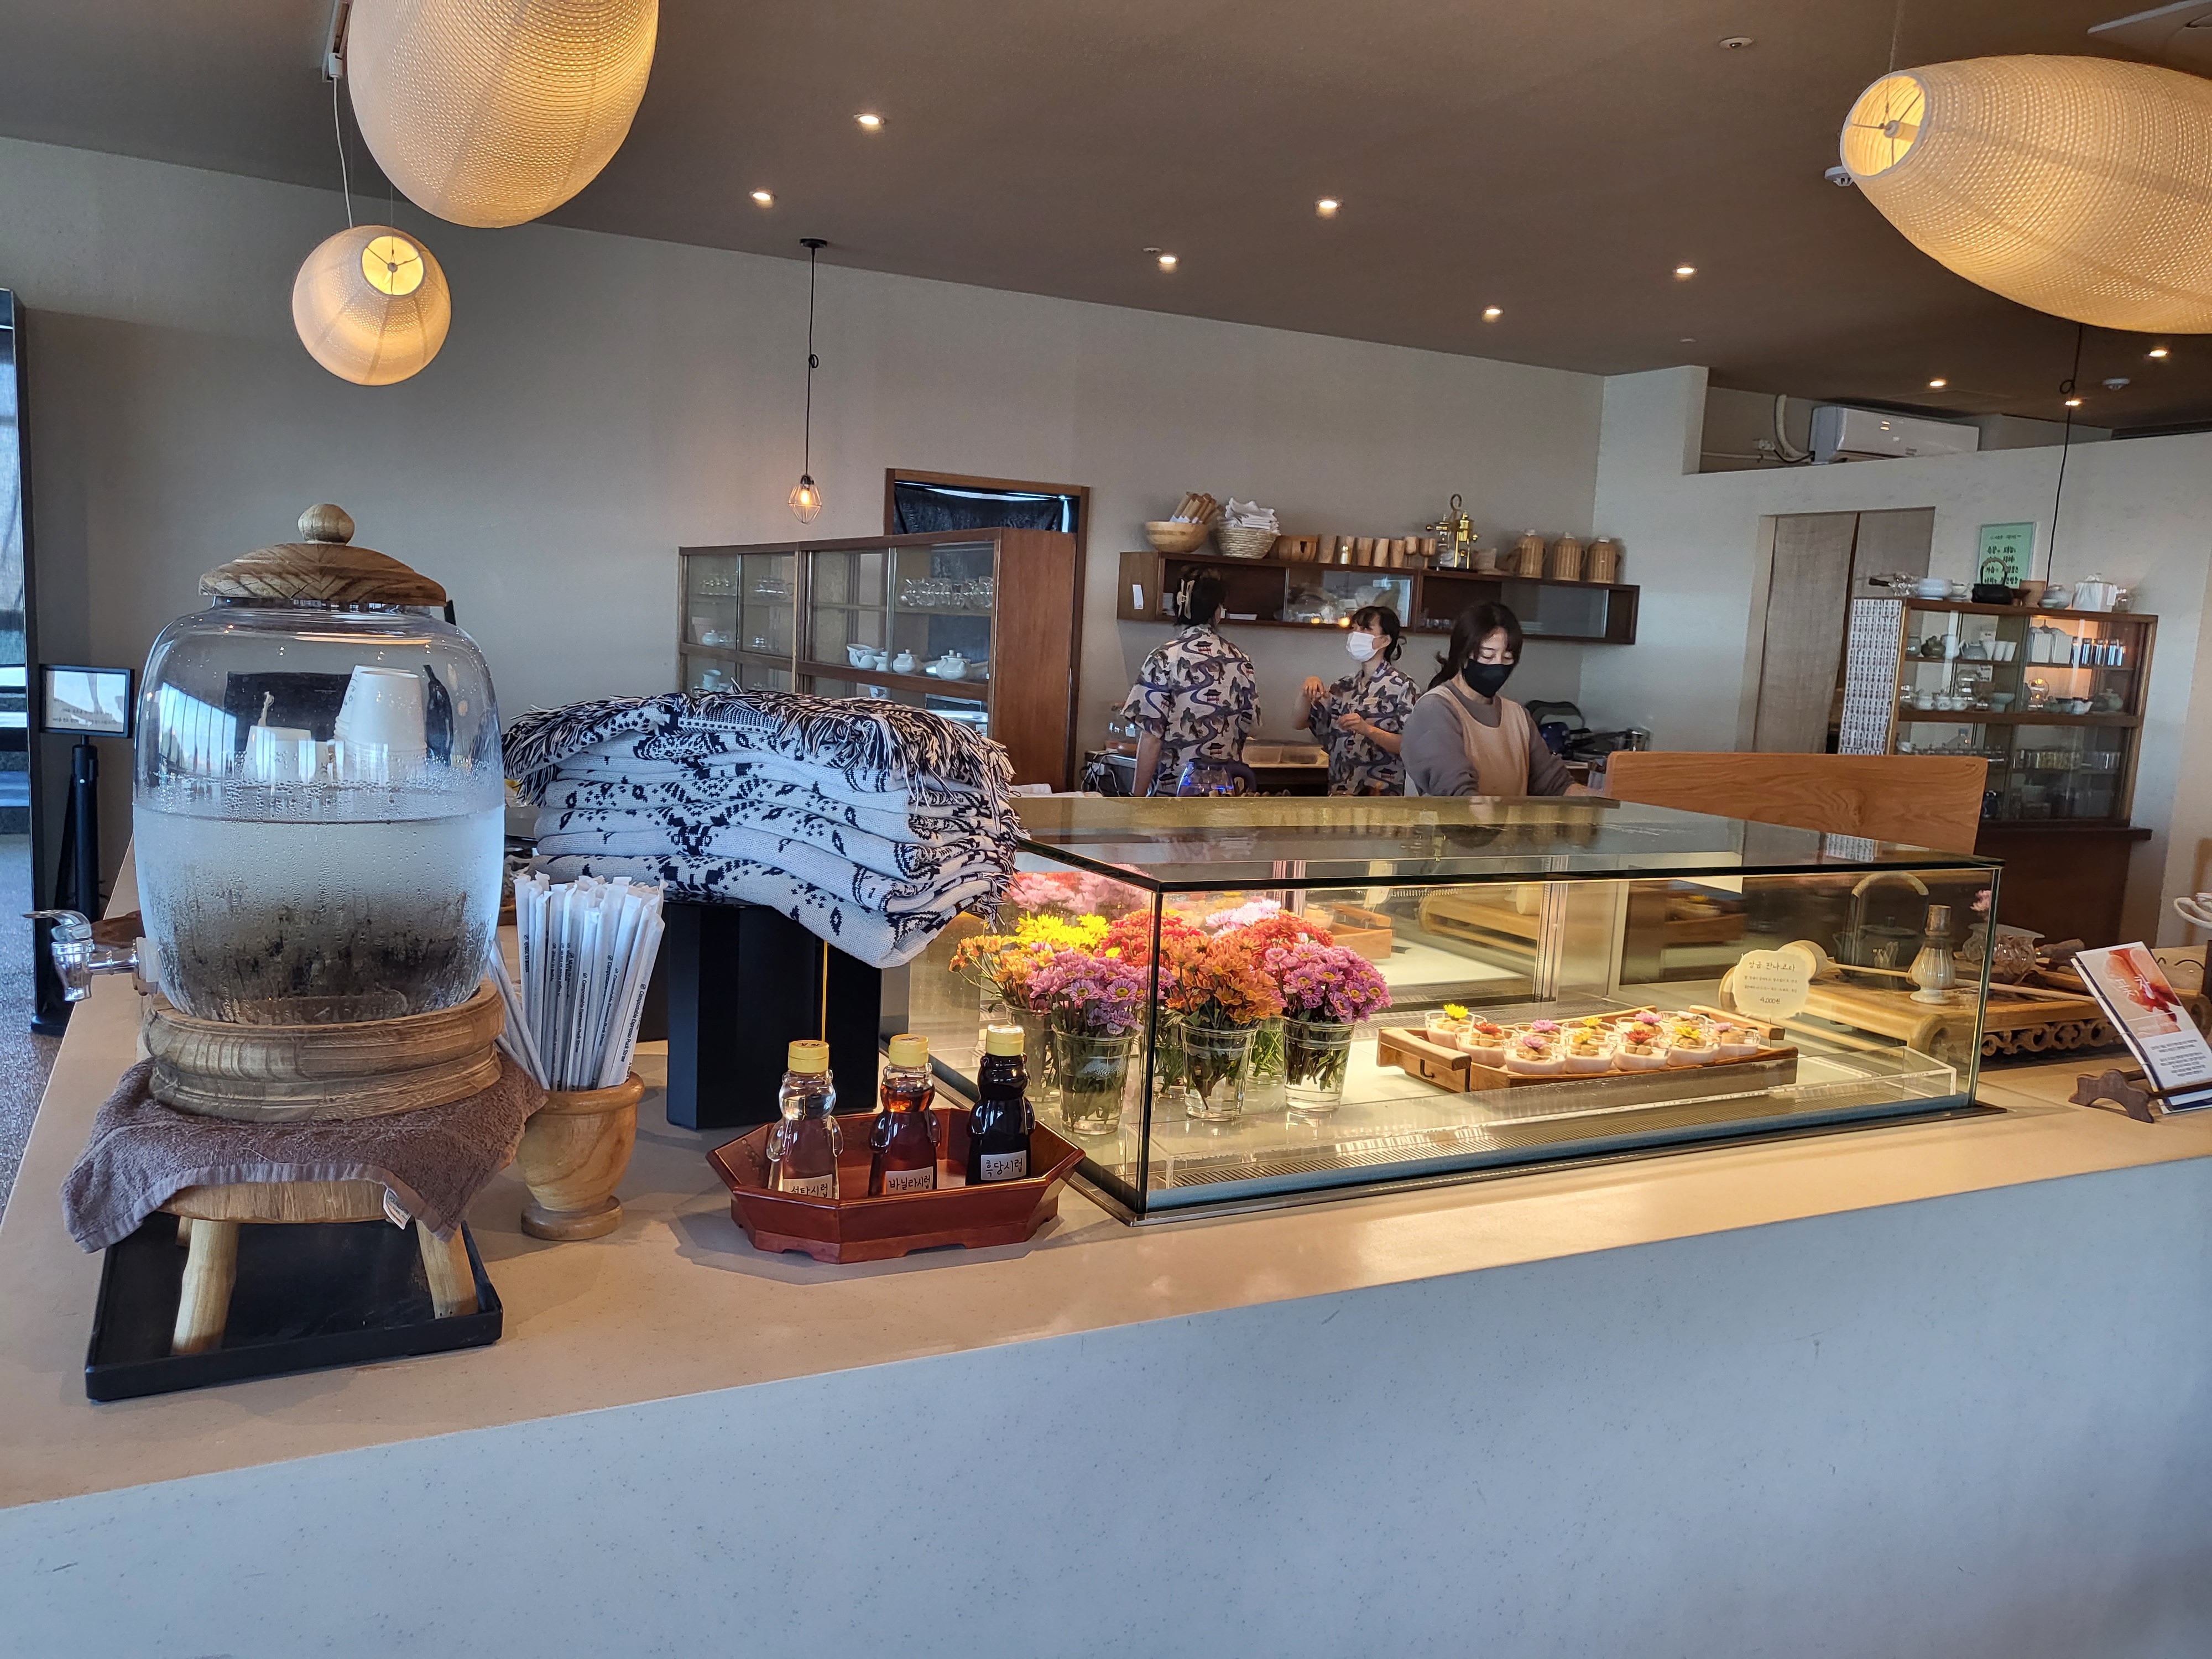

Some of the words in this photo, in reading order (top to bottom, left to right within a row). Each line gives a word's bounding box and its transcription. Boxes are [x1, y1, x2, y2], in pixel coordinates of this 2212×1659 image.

[1749, 961, 1762, 969] 앙금
[632, 990, 644, 1019] Compostable
[627, 1018, 637, 1039] Espresso
[985, 1157, 1022, 1177] 흑당시럽
[889, 1174, 931, 1191] 바닐라시럽
